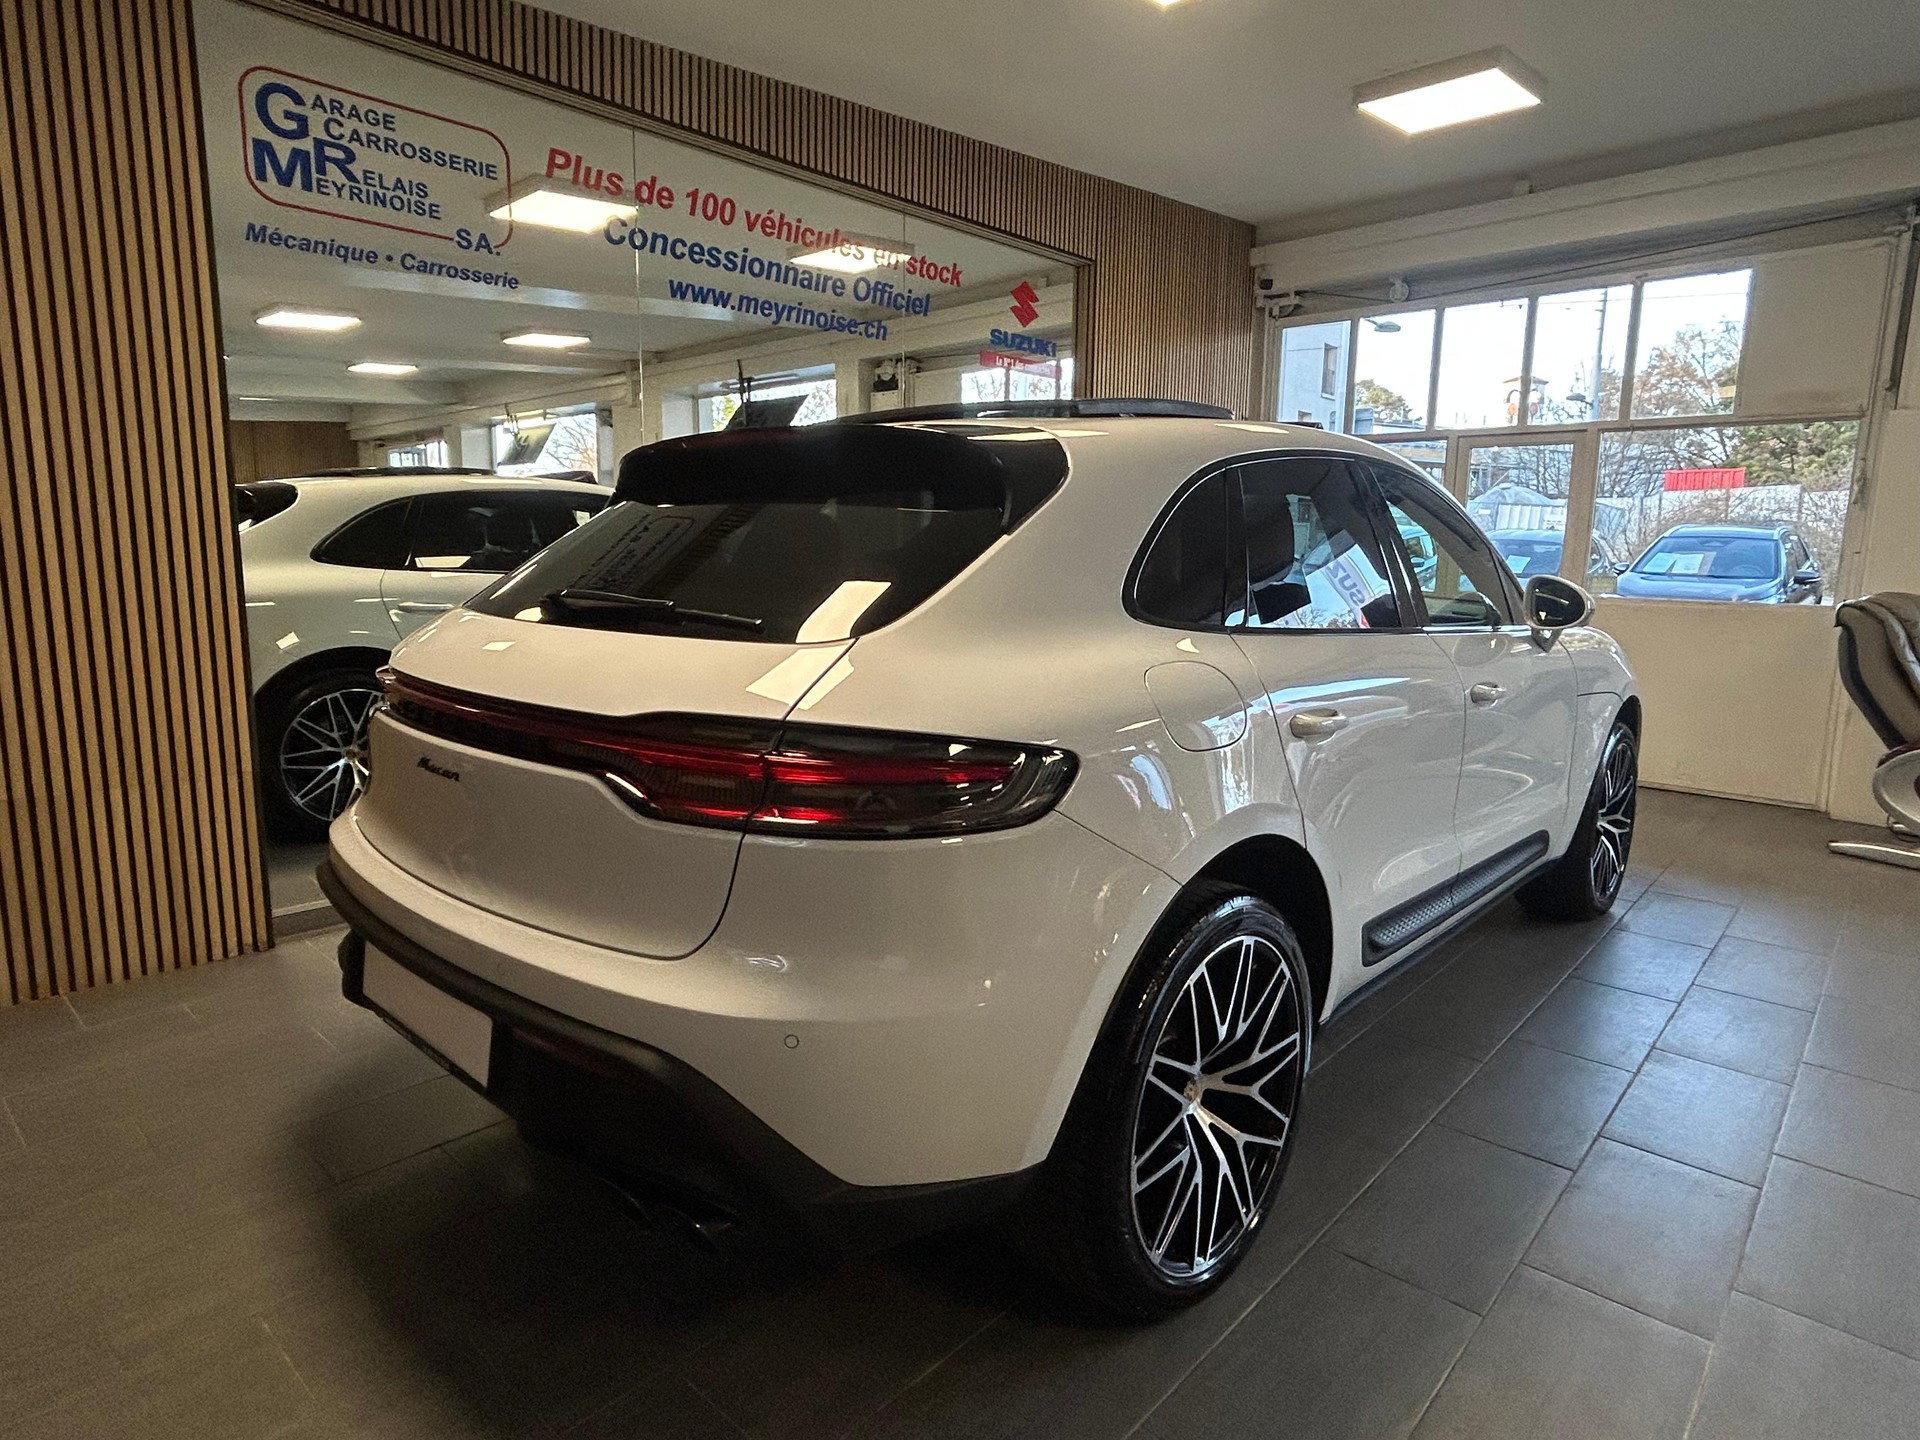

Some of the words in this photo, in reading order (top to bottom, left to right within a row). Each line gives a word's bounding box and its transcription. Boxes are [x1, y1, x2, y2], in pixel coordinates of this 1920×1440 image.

[255, 82, 396, 140] GARAGE
[252, 137, 441, 220] MEYRINOISE
[312, 136, 429, 199] RELAIS
[323, 117, 498, 181] CARROSSERIE
[545, 147, 624, 197] Plus
[635, 175, 674, 209] de
[686, 188, 736, 226] 100
[744, 208, 865, 261] véhicules
[906, 254, 964, 287] stock
[245, 222, 379, 264] Mécanique
[400, 253, 520, 290] Carrosserie
[603, 215, 846, 297] Concessionnaire
[853, 276, 931, 317] Officiel
[668, 279, 888, 341] www.meyrinoise.ch
[990, 328, 1057, 358] SUZUKI
